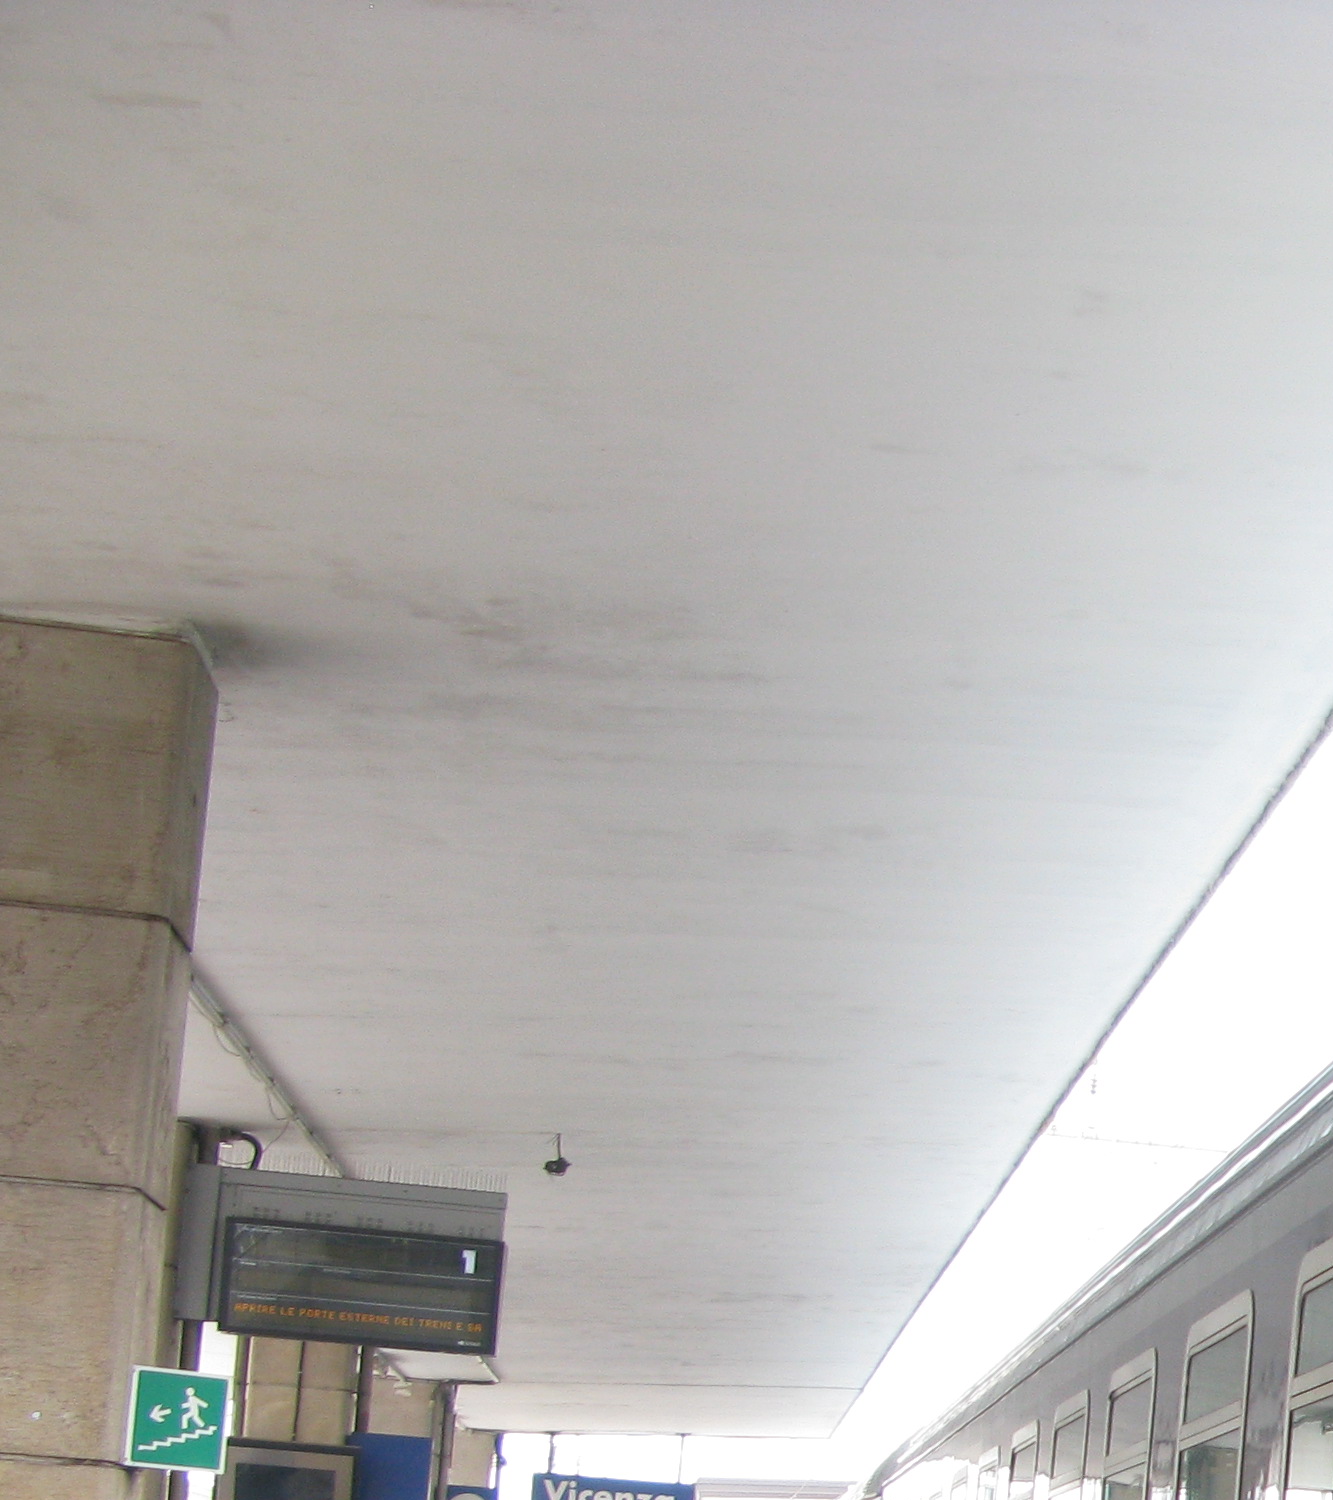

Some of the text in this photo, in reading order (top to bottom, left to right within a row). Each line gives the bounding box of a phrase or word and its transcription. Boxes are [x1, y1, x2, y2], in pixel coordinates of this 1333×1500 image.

[461, 1249, 478, 1274] 1
[233, 1302, 277, 1315] APRIRE
[279, 1306, 295, 1317] LE
[299, 1307, 335, 1320] PORTE
[339, 1310, 390, 1325] ESTERNE
[394, 1315, 415, 1327] DEI
